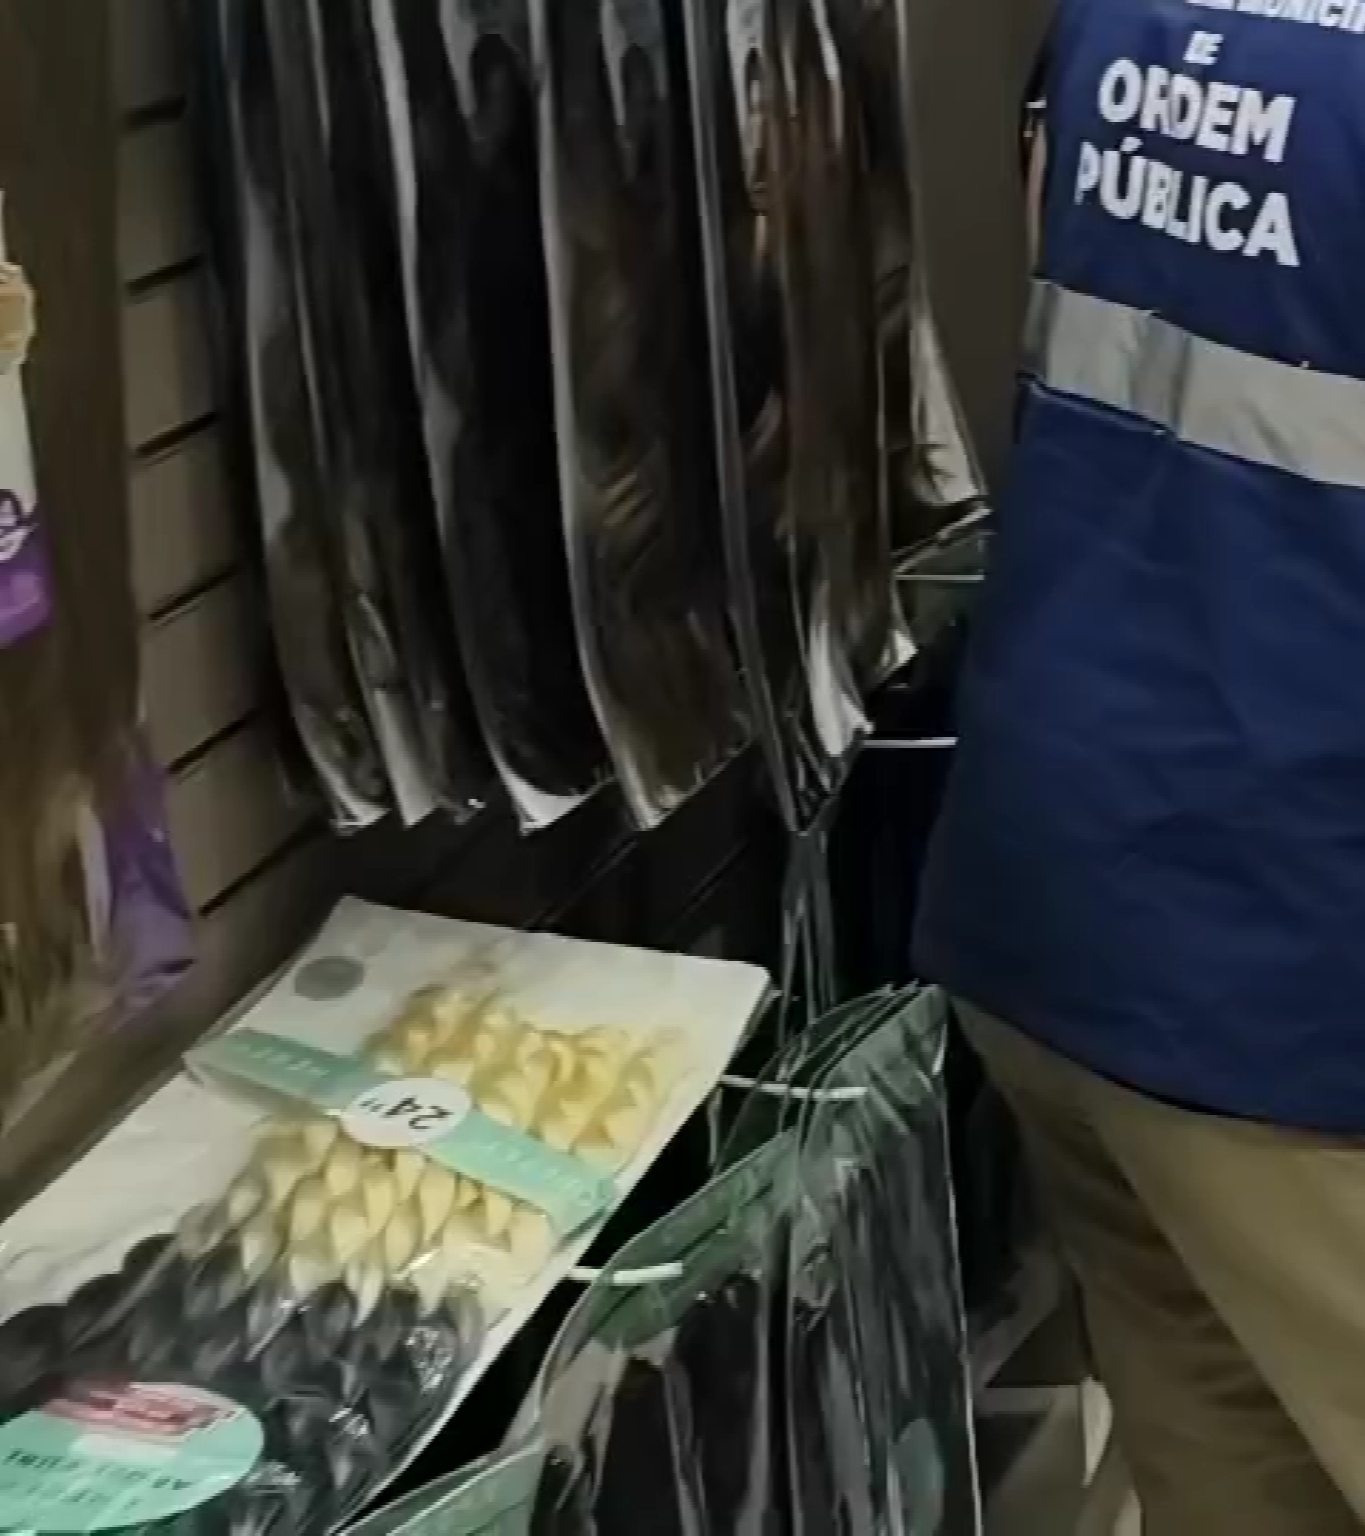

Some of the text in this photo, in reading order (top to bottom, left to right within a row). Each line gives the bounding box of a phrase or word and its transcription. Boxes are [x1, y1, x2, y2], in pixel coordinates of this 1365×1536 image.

[1184, 30, 1224, 66] DE
[1097, 57, 1297, 163] ORDEM
[1074, 135, 1300, 267] PÚBLICA
